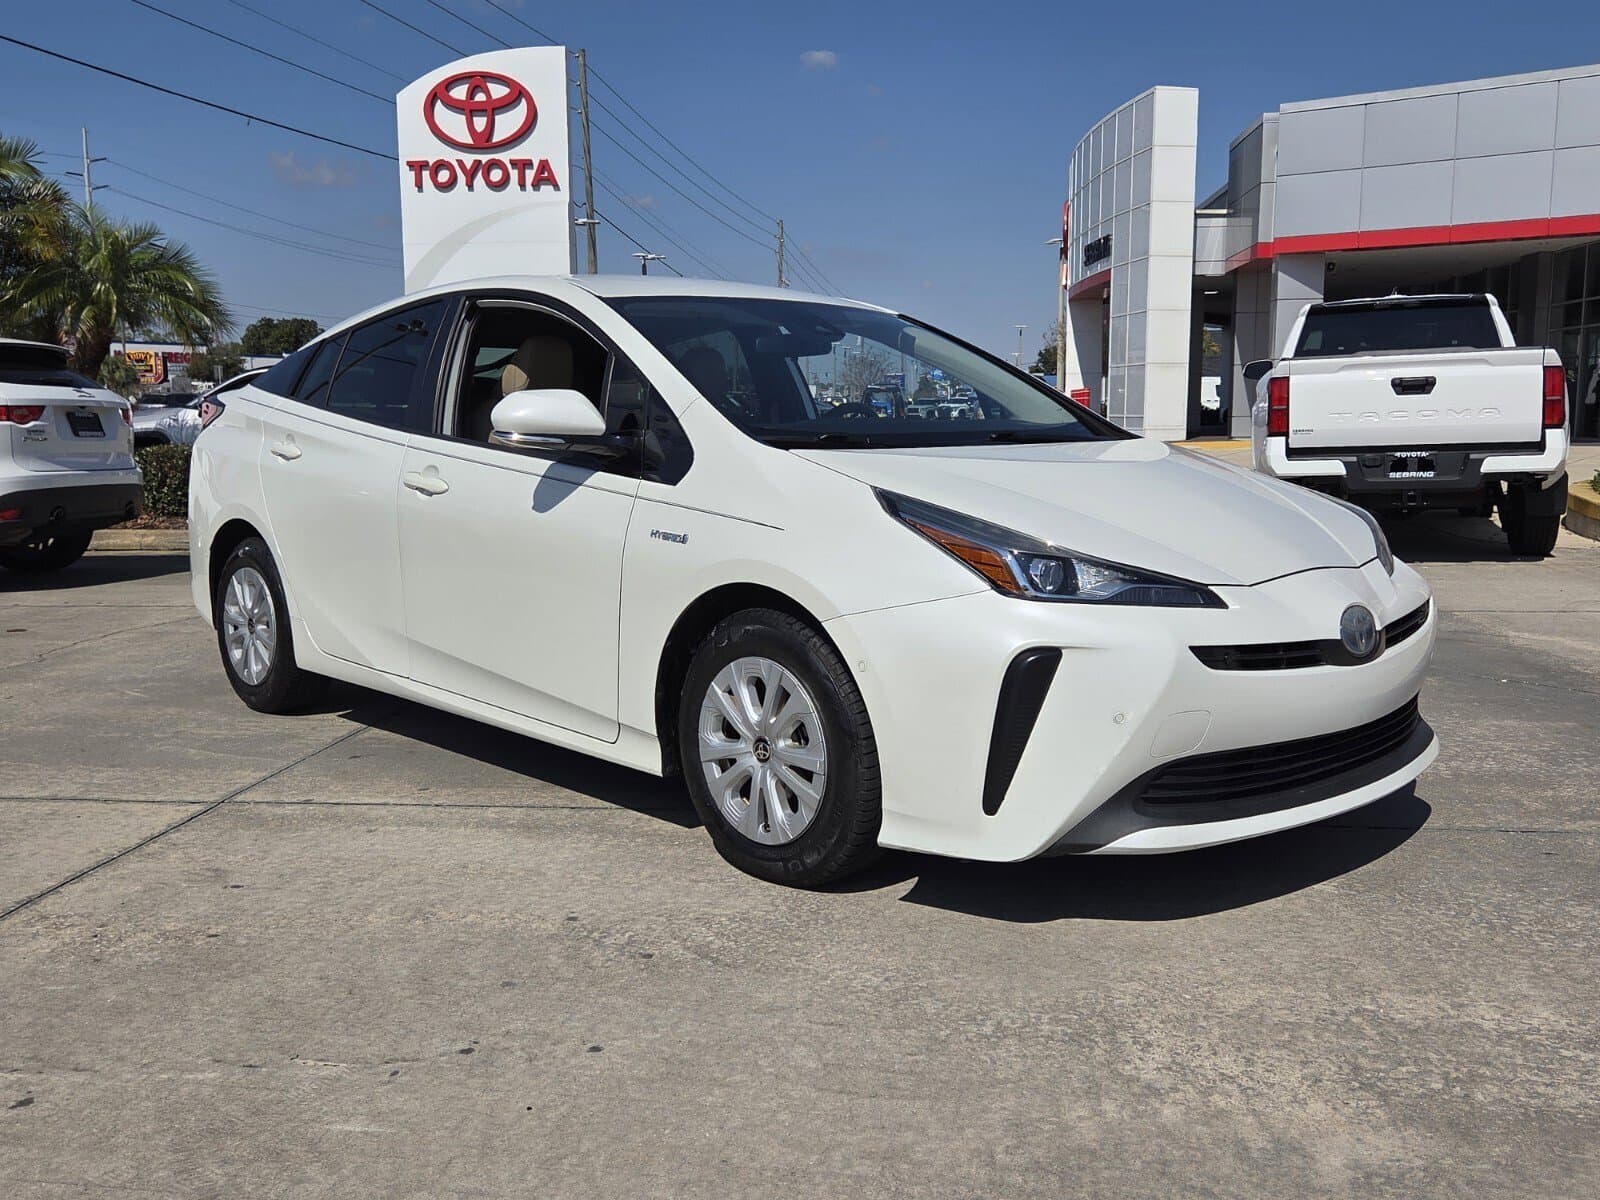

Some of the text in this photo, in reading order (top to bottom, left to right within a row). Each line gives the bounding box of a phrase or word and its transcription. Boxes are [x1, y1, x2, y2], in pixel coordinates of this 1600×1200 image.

[406, 158, 560, 191] TOYOTA
[1328, 407, 1502, 423] TACOMA
[650, 529, 684, 543] HYBRID
